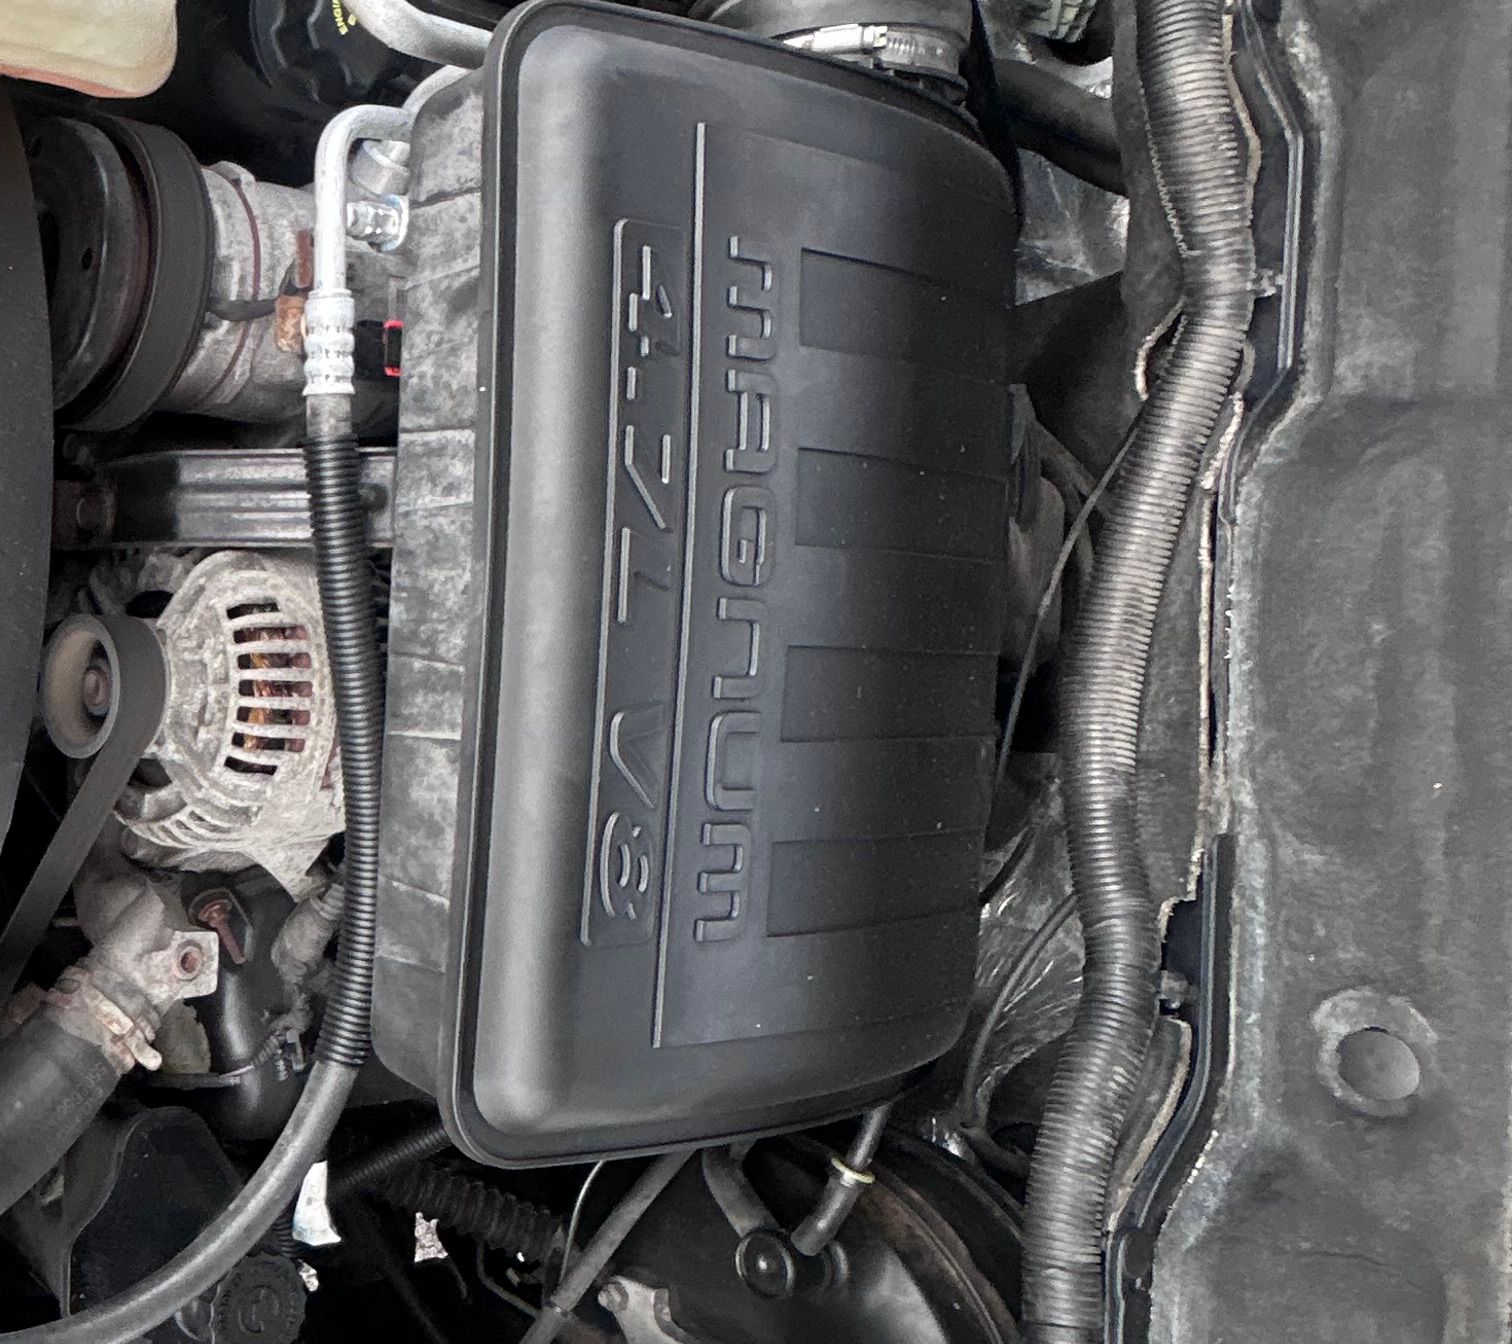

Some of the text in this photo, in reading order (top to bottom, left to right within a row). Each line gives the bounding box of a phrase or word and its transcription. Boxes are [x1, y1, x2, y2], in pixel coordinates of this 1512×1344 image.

[596, 244, 682, 920] 4.7L V8
[693, 234, 782, 944] MAGNUM
